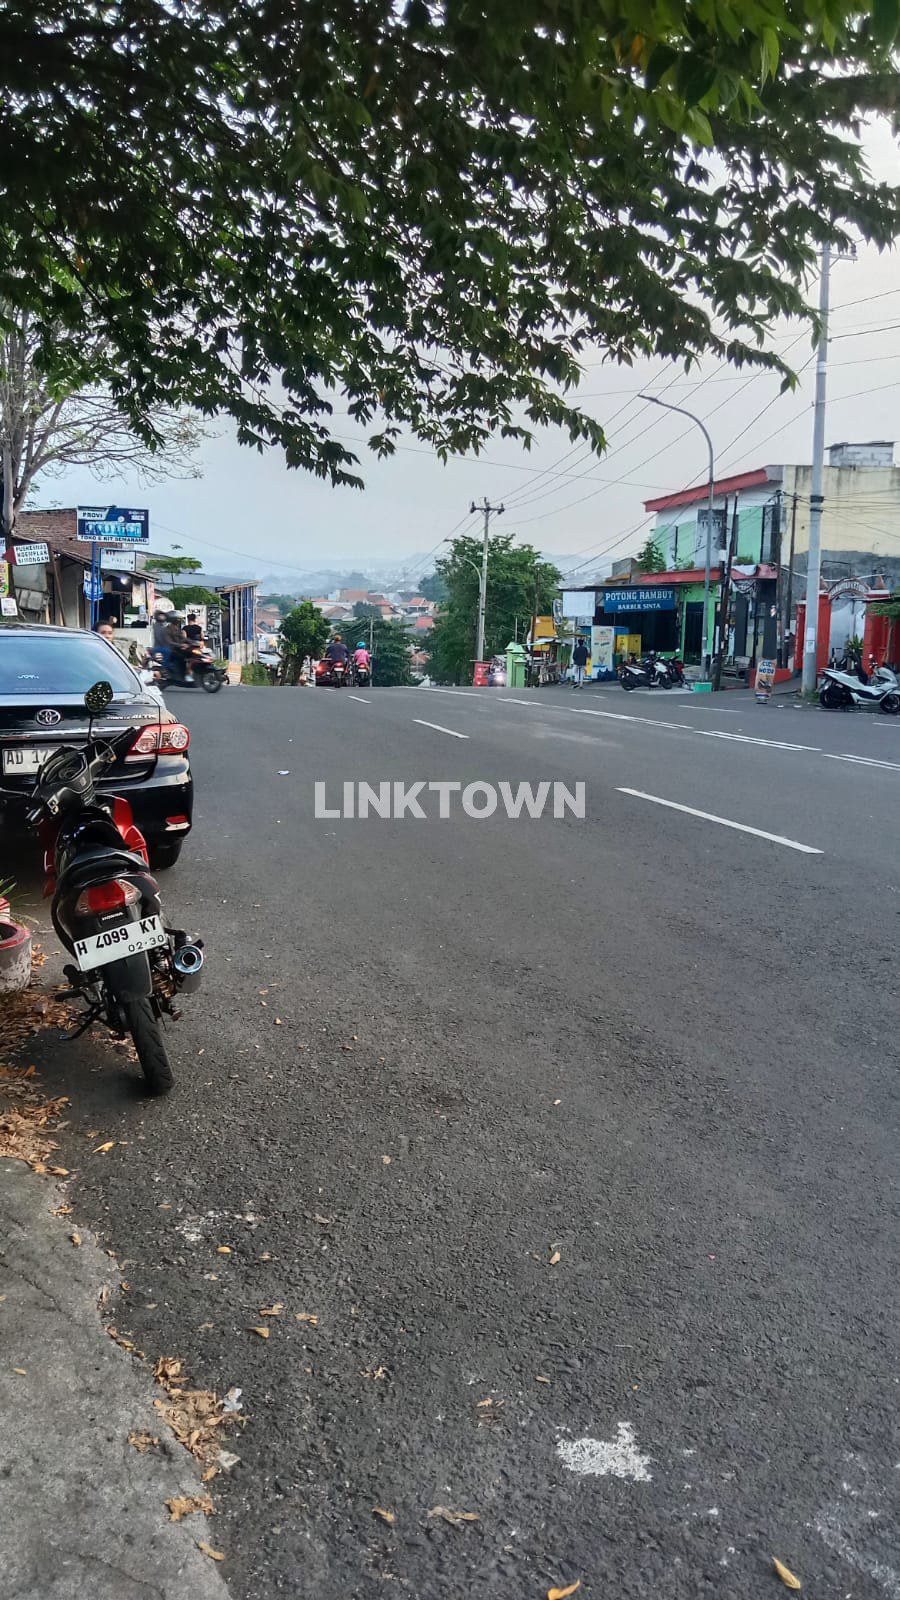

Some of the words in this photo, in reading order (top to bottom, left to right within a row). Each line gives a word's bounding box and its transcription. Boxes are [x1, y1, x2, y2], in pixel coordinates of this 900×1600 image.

[605, 591, 637, 601] POTONG
[639, 590, 673, 600] RAMBUT
[7, 750, 24, 765] AD
[32, 750, 48, 764] 17
[76, 941, 88, 956] H
[96, 928, 129, 949] 4099
[139, 917, 156, 934] KY
